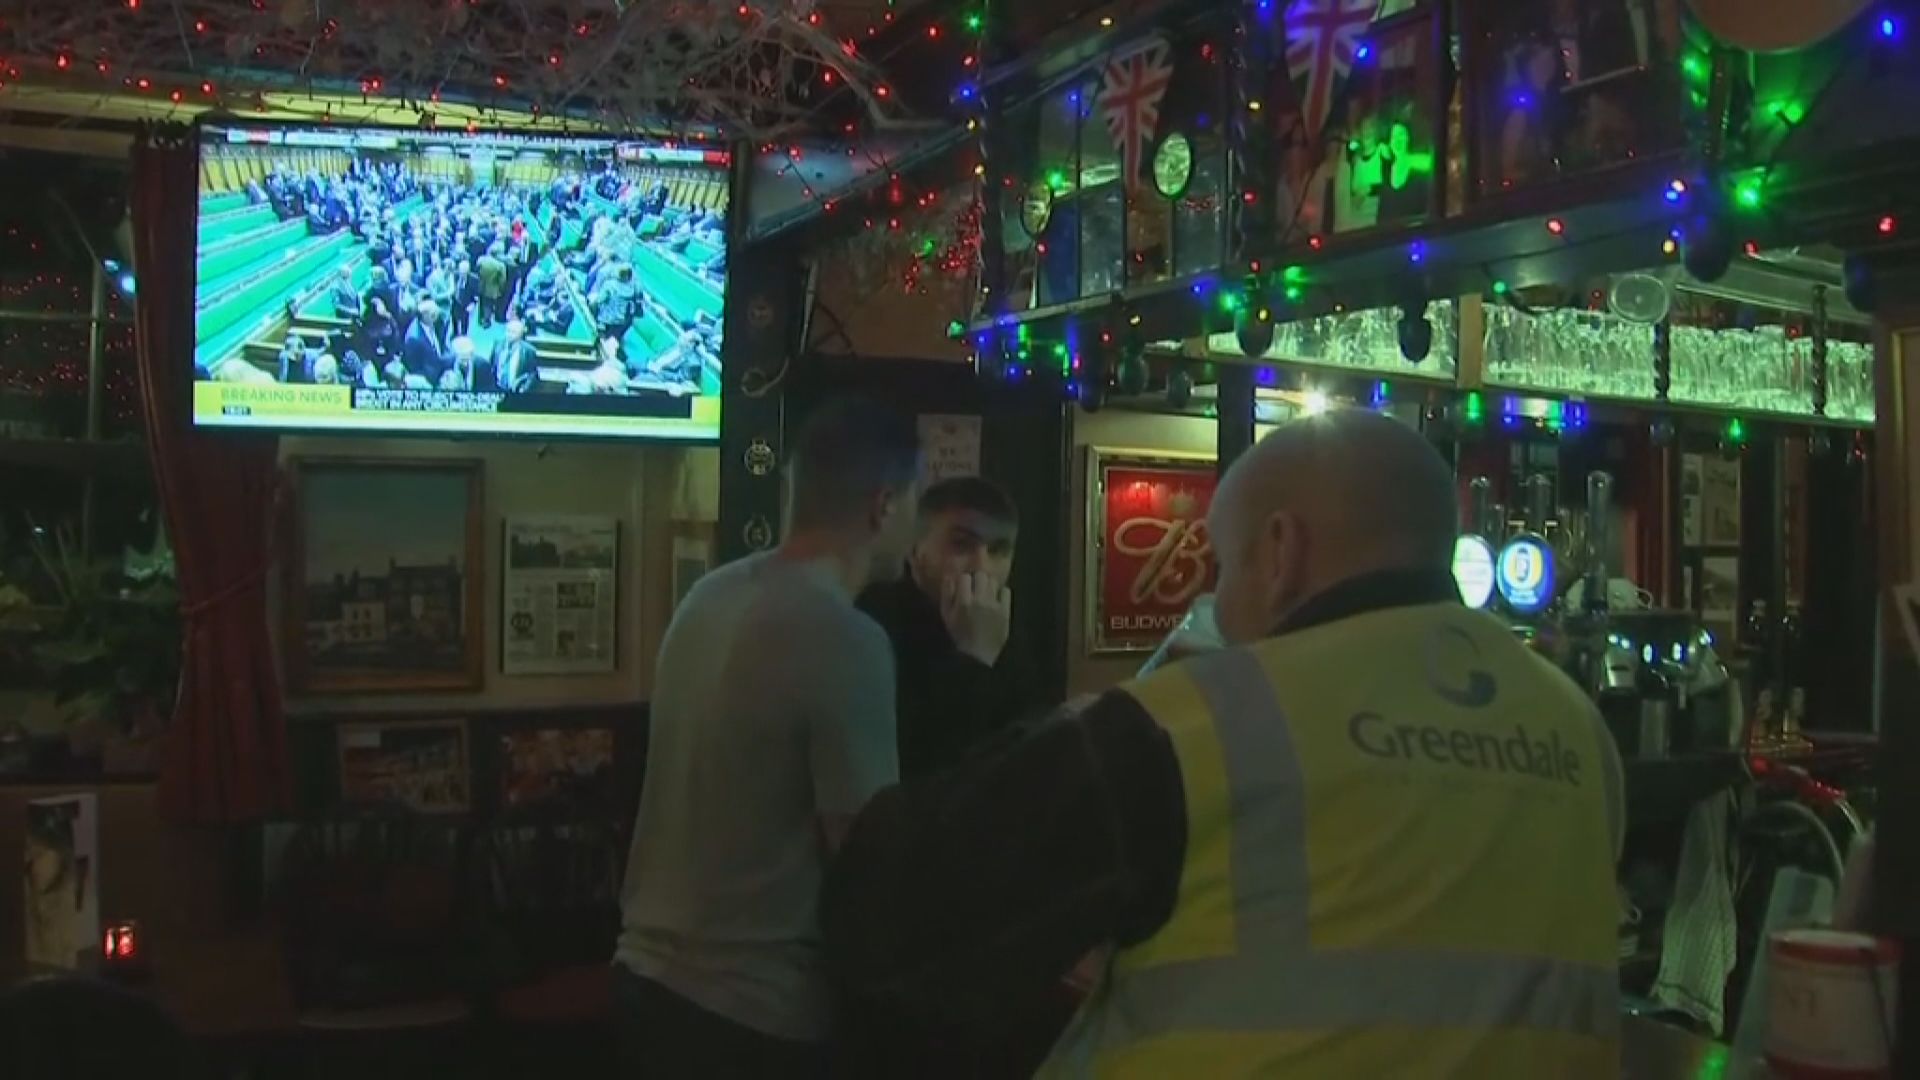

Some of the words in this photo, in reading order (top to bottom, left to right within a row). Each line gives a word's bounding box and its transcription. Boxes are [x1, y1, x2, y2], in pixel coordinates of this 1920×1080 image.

[220, 388, 295, 403] BREAKING
[300, 391, 342, 404] NEWS
[1348, 711, 1582, 788] Greendale
